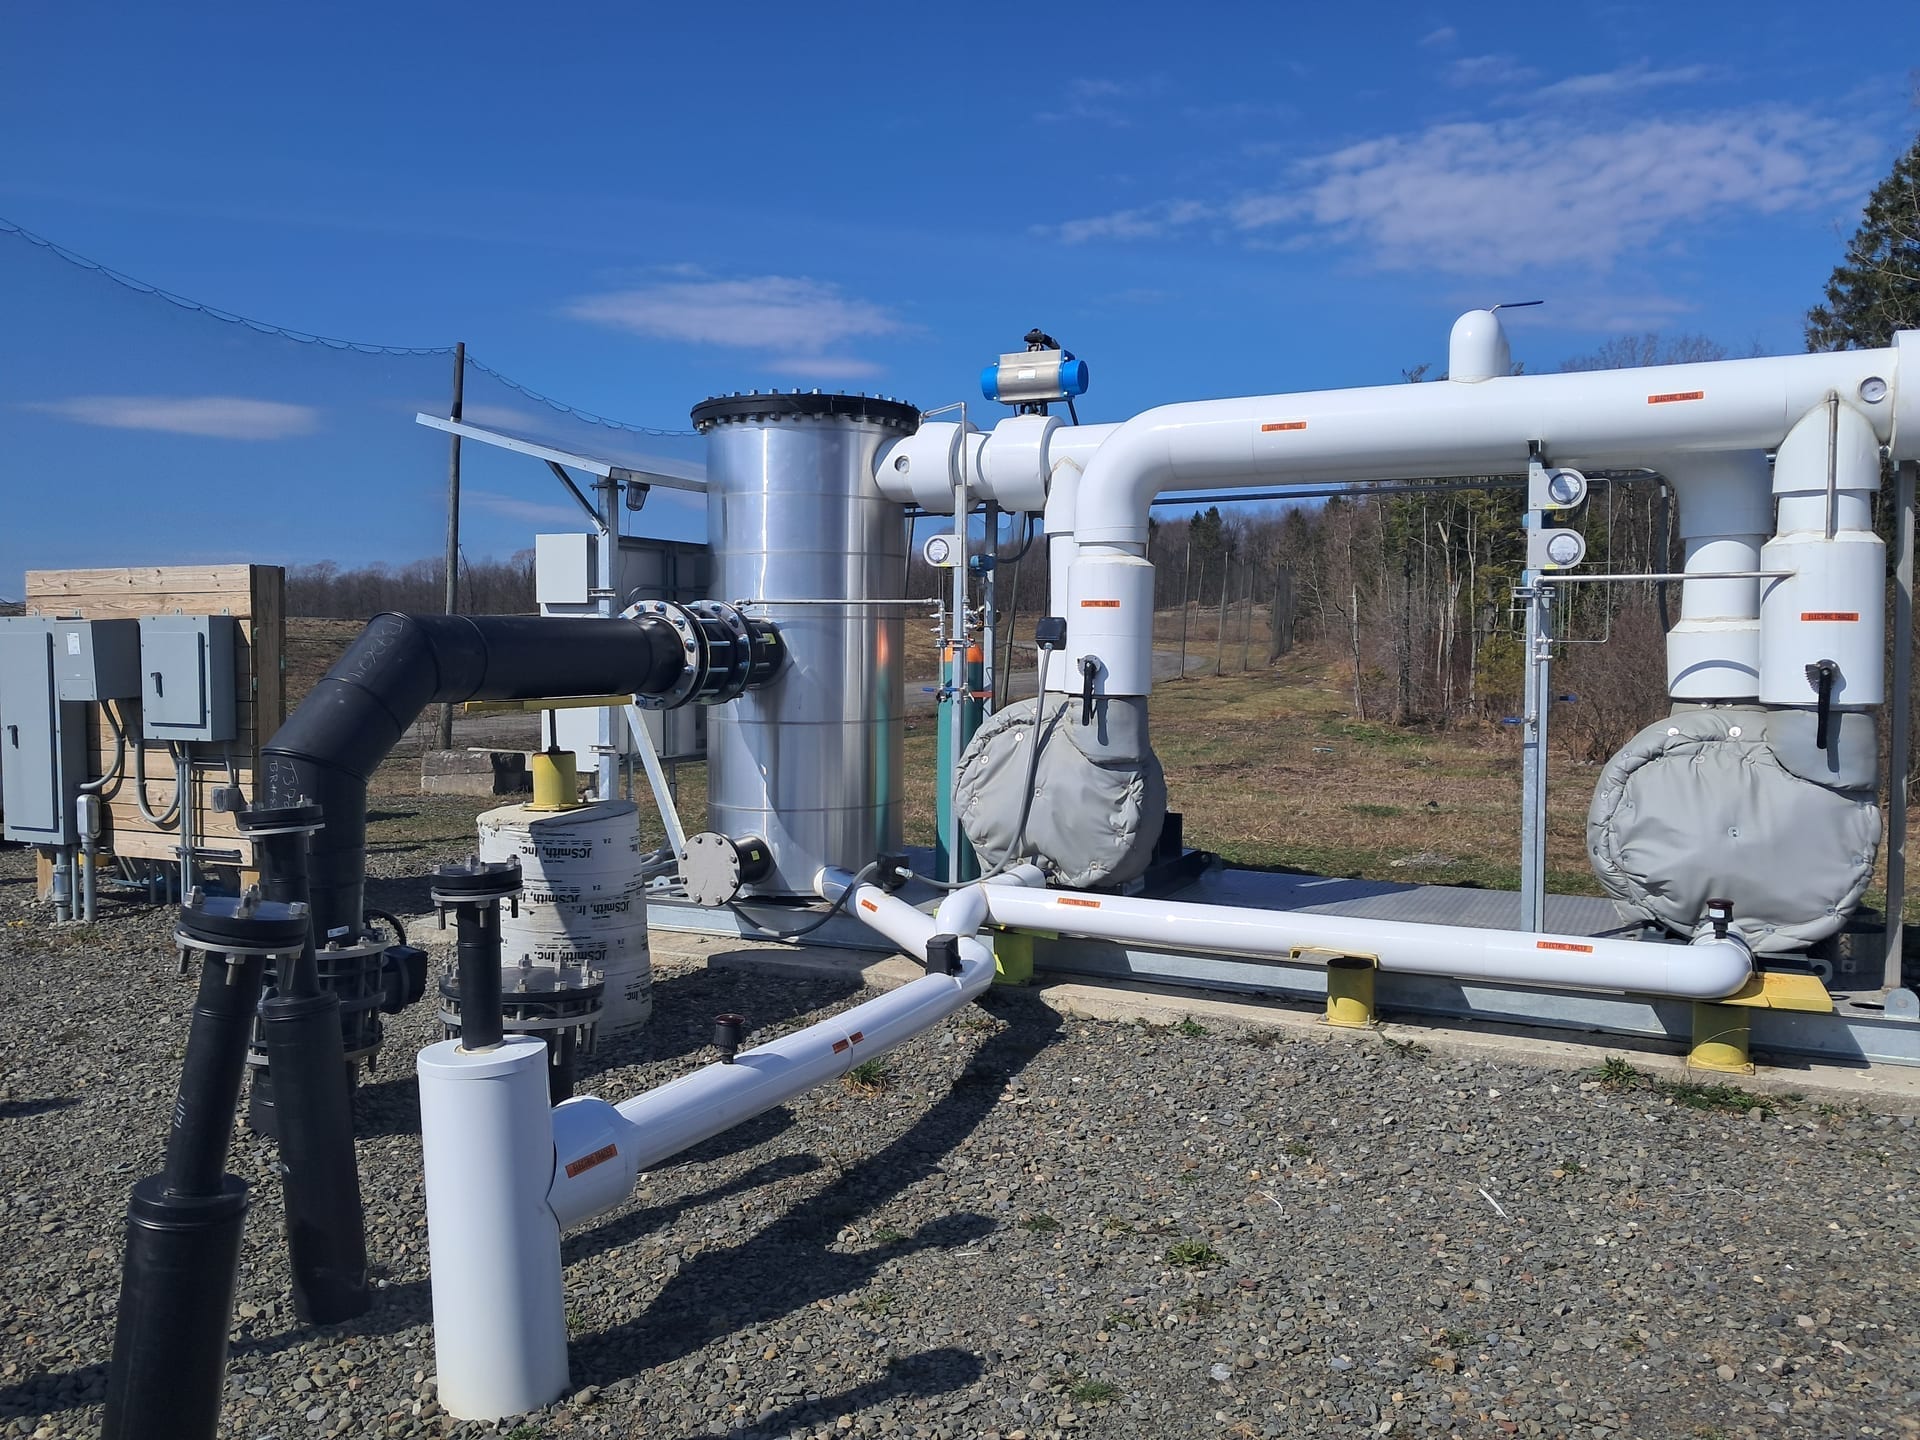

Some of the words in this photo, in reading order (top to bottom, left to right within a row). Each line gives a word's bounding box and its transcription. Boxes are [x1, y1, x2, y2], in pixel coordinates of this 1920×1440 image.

[519, 845, 539, 858] Inc.
[543, 845, 593, 859] JCSmith,
[534, 951, 556, 963] Inc.
